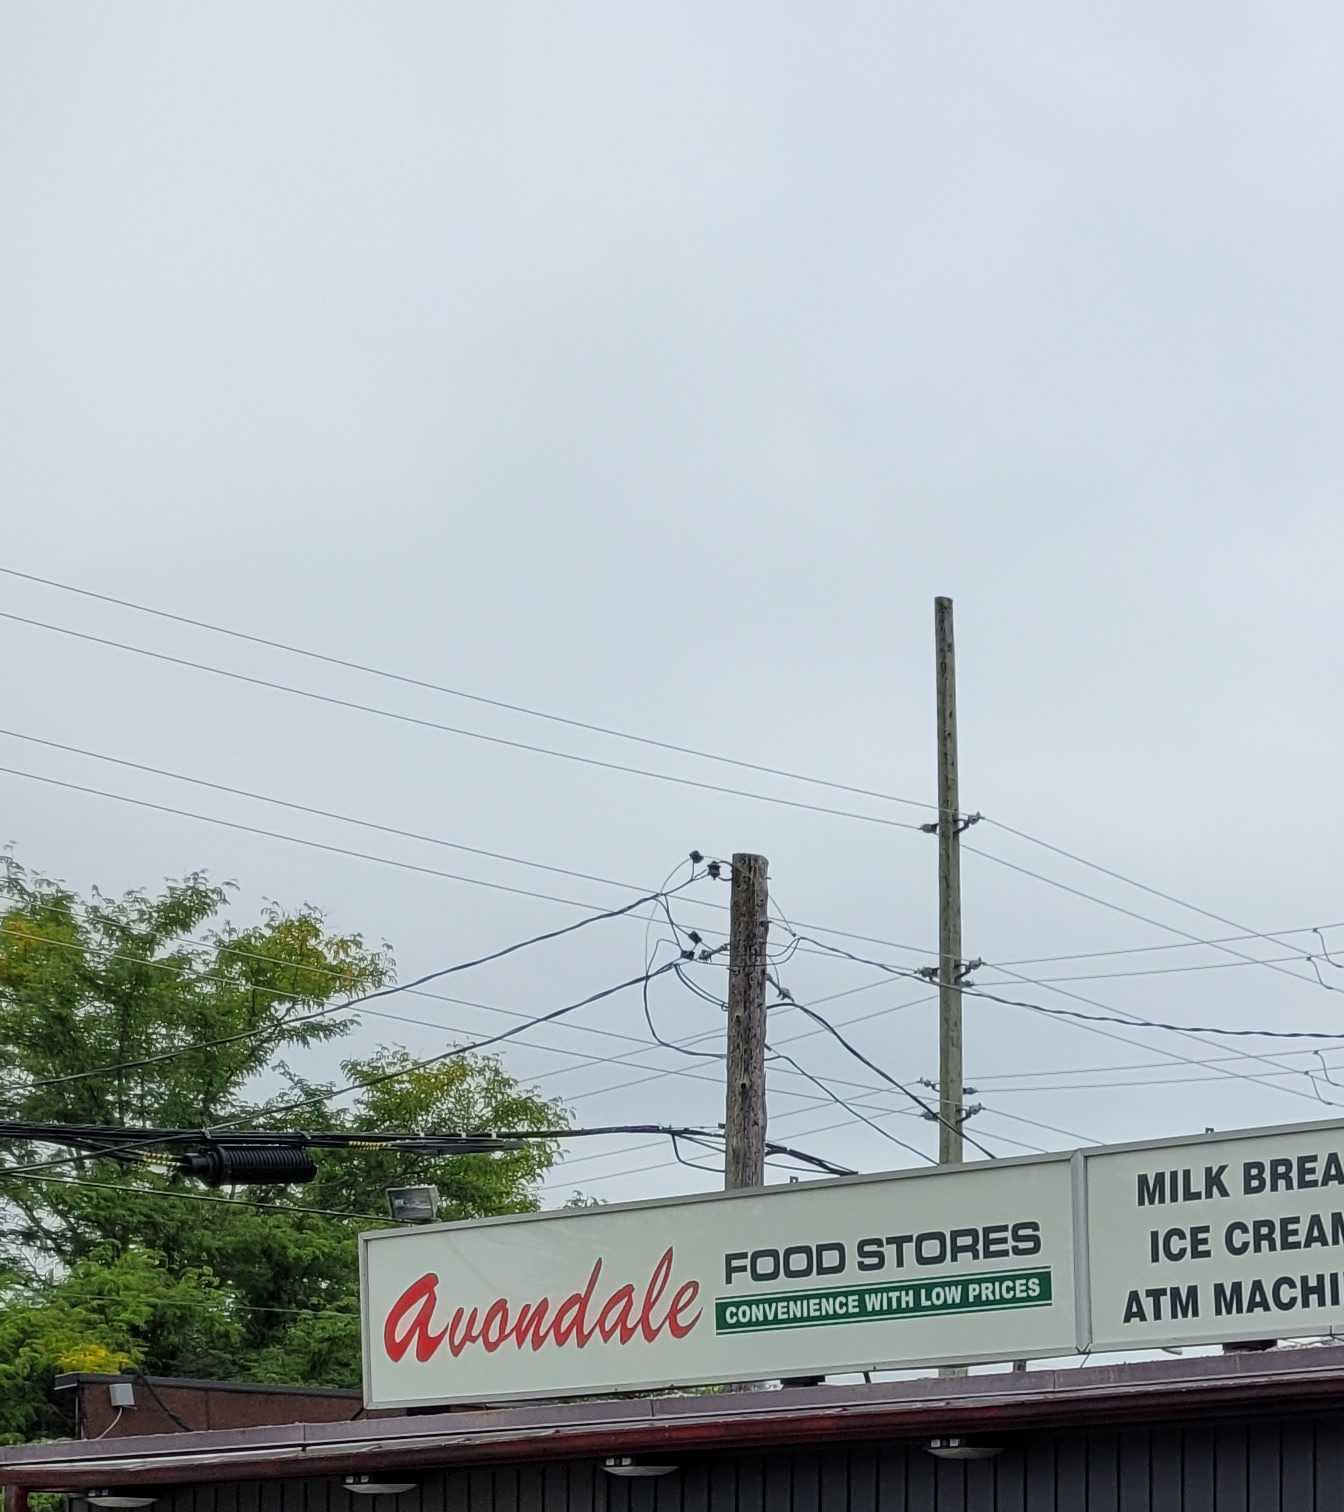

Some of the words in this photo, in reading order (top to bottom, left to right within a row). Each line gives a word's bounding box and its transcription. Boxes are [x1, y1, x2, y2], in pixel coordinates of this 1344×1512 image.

[1136, 1163, 1230, 1207] MILK
[724, 1239, 846, 1285] FOOD
[856, 1221, 1042, 1272] STORES
[1150, 1224, 1211, 1263] ICE
[384, 1246, 702, 1363] Avondale
[725, 1294, 860, 1325] CONVENIENCE
[864, 1289, 915, 1314] WITH
[919, 1285, 964, 1309] LOW
[968, 1277, 1041, 1303] PRICES
[1122, 1284, 1200, 1324] ATM
